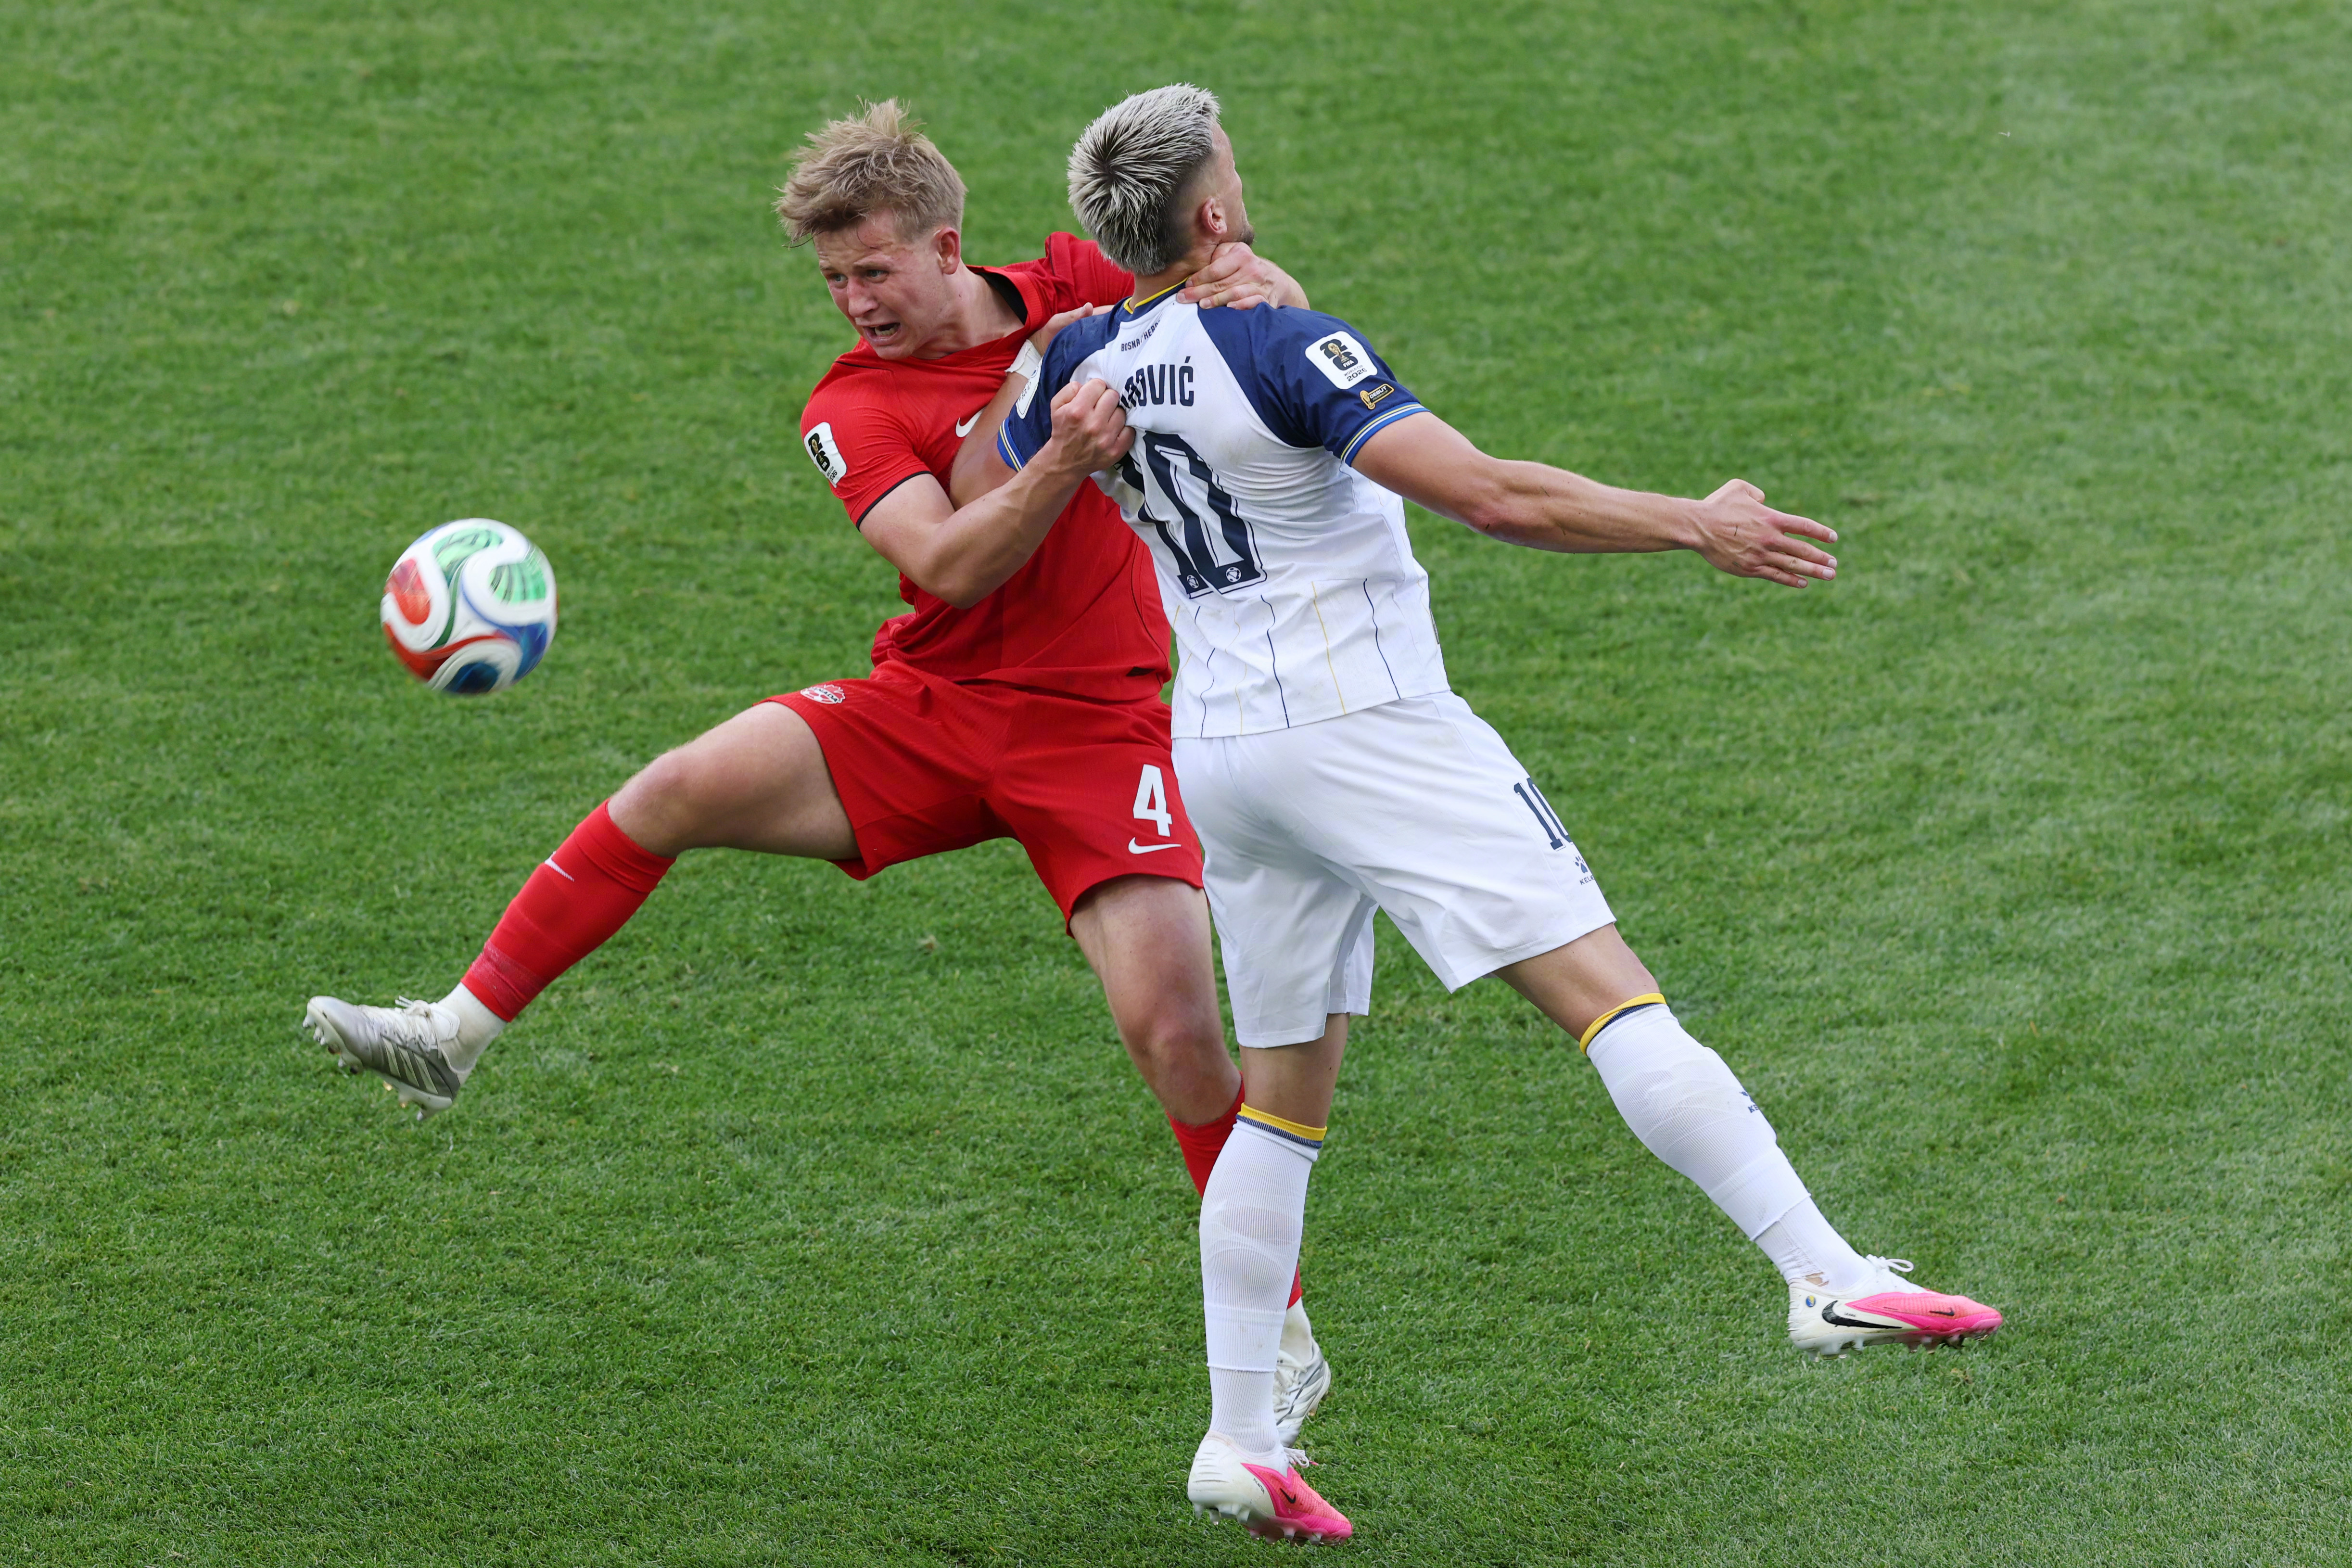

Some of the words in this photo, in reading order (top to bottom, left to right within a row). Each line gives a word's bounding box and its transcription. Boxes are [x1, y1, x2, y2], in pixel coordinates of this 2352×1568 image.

[1121, 320, 1161, 352] BOSNA/HER
[1344, 367, 1357, 377] WORLD
[1347, 368, 1367, 382] 2026
[1369, 386, 1386, 399] DEBUT
[1114, 430, 1268, 599] 10
[1133, 764, 1173, 837] 4
